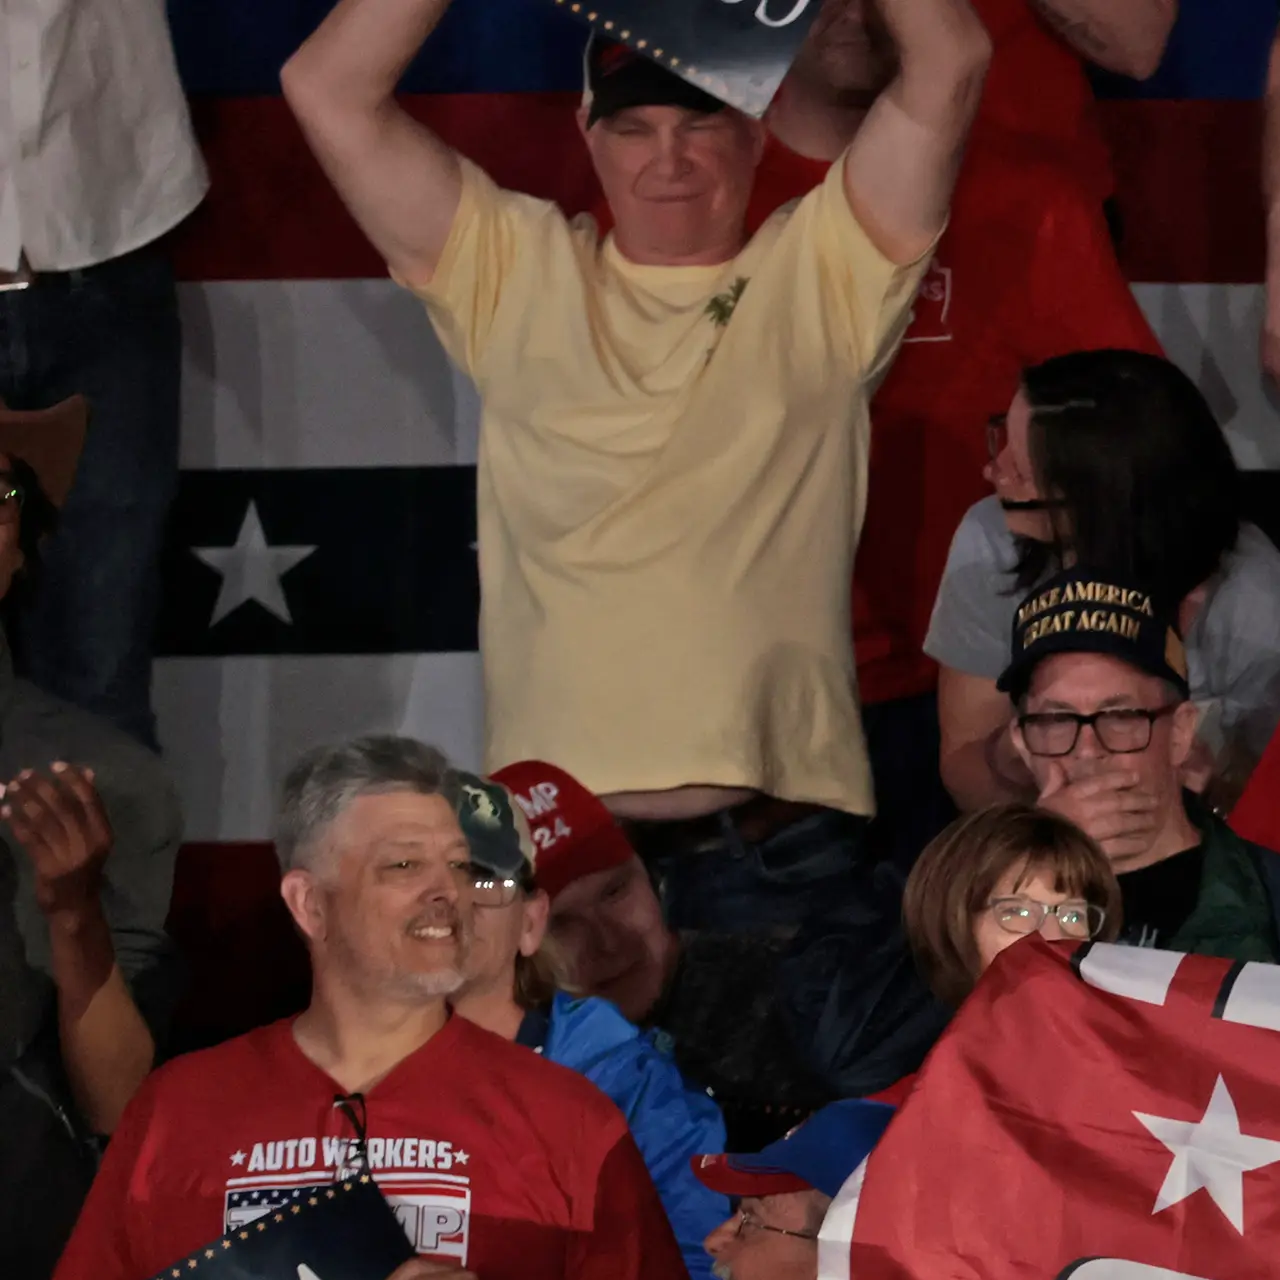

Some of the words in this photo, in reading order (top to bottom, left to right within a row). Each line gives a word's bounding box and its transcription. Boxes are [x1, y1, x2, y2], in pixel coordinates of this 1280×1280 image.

[1018, 586, 1061, 627] MAKE
[1061, 580, 1153, 618] AMERICA
[1023, 610, 1075, 651] GREAT
[1076, 609, 1142, 644] AGAIN
[247, 1137, 317, 1173] AUTO
